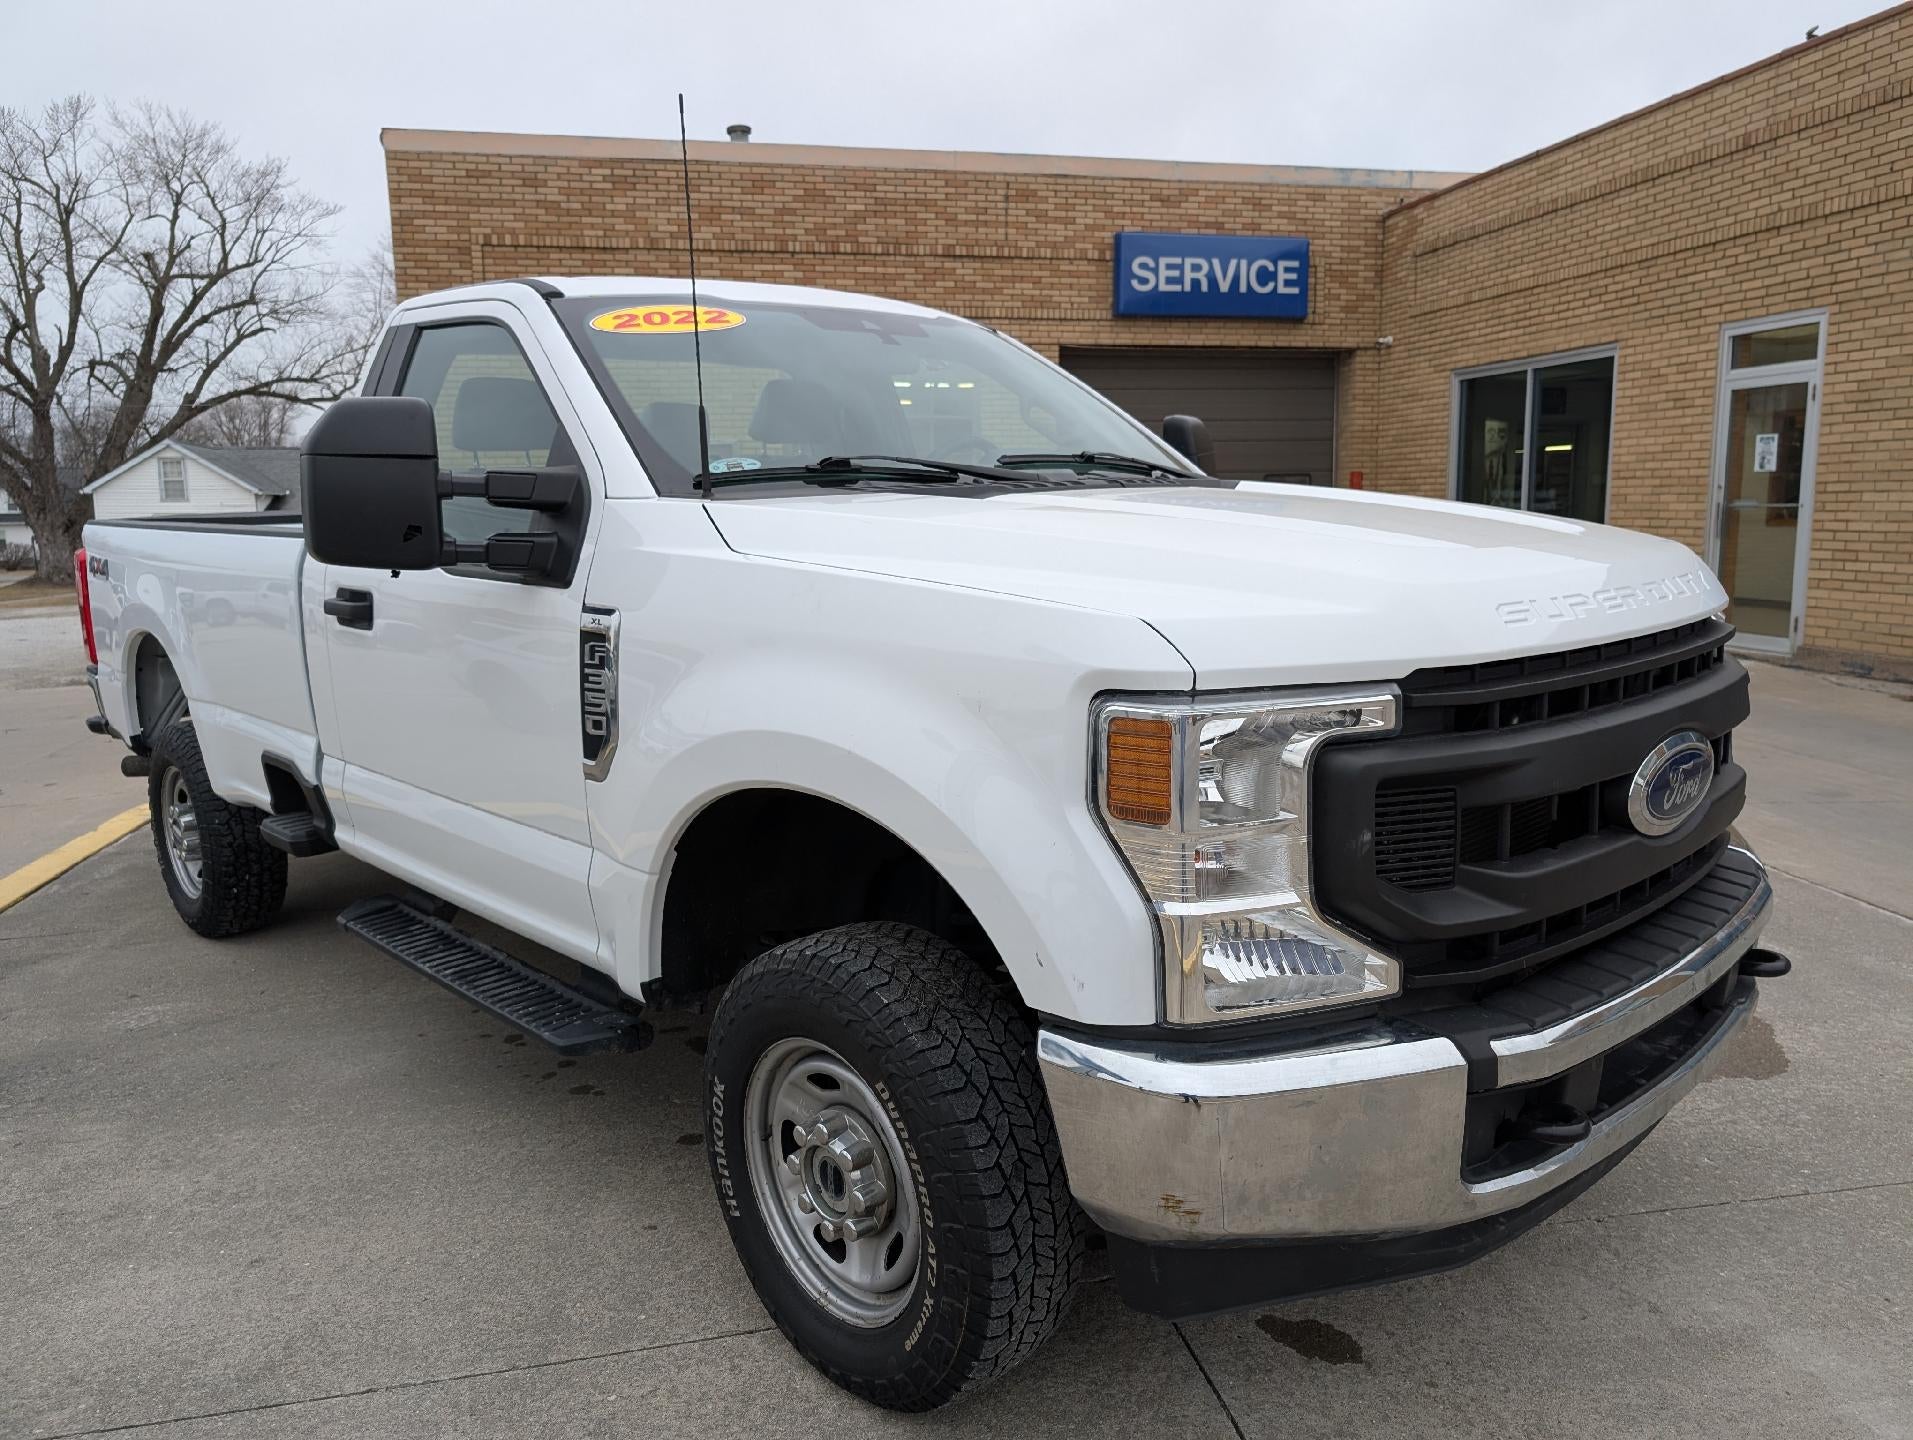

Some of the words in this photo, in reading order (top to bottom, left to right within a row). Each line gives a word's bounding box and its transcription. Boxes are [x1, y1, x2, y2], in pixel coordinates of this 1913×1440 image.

[1130, 256, 1300, 294] SERVICE
[612, 310, 730, 329] 2022
[590, 617, 603, 626] XL
[1496, 586, 1643, 627] SUPER
[1663, 760, 1704, 810] Ford
[926, 1233, 937, 1288] AT2
[904, 1289, 934, 1351] Xtreme
